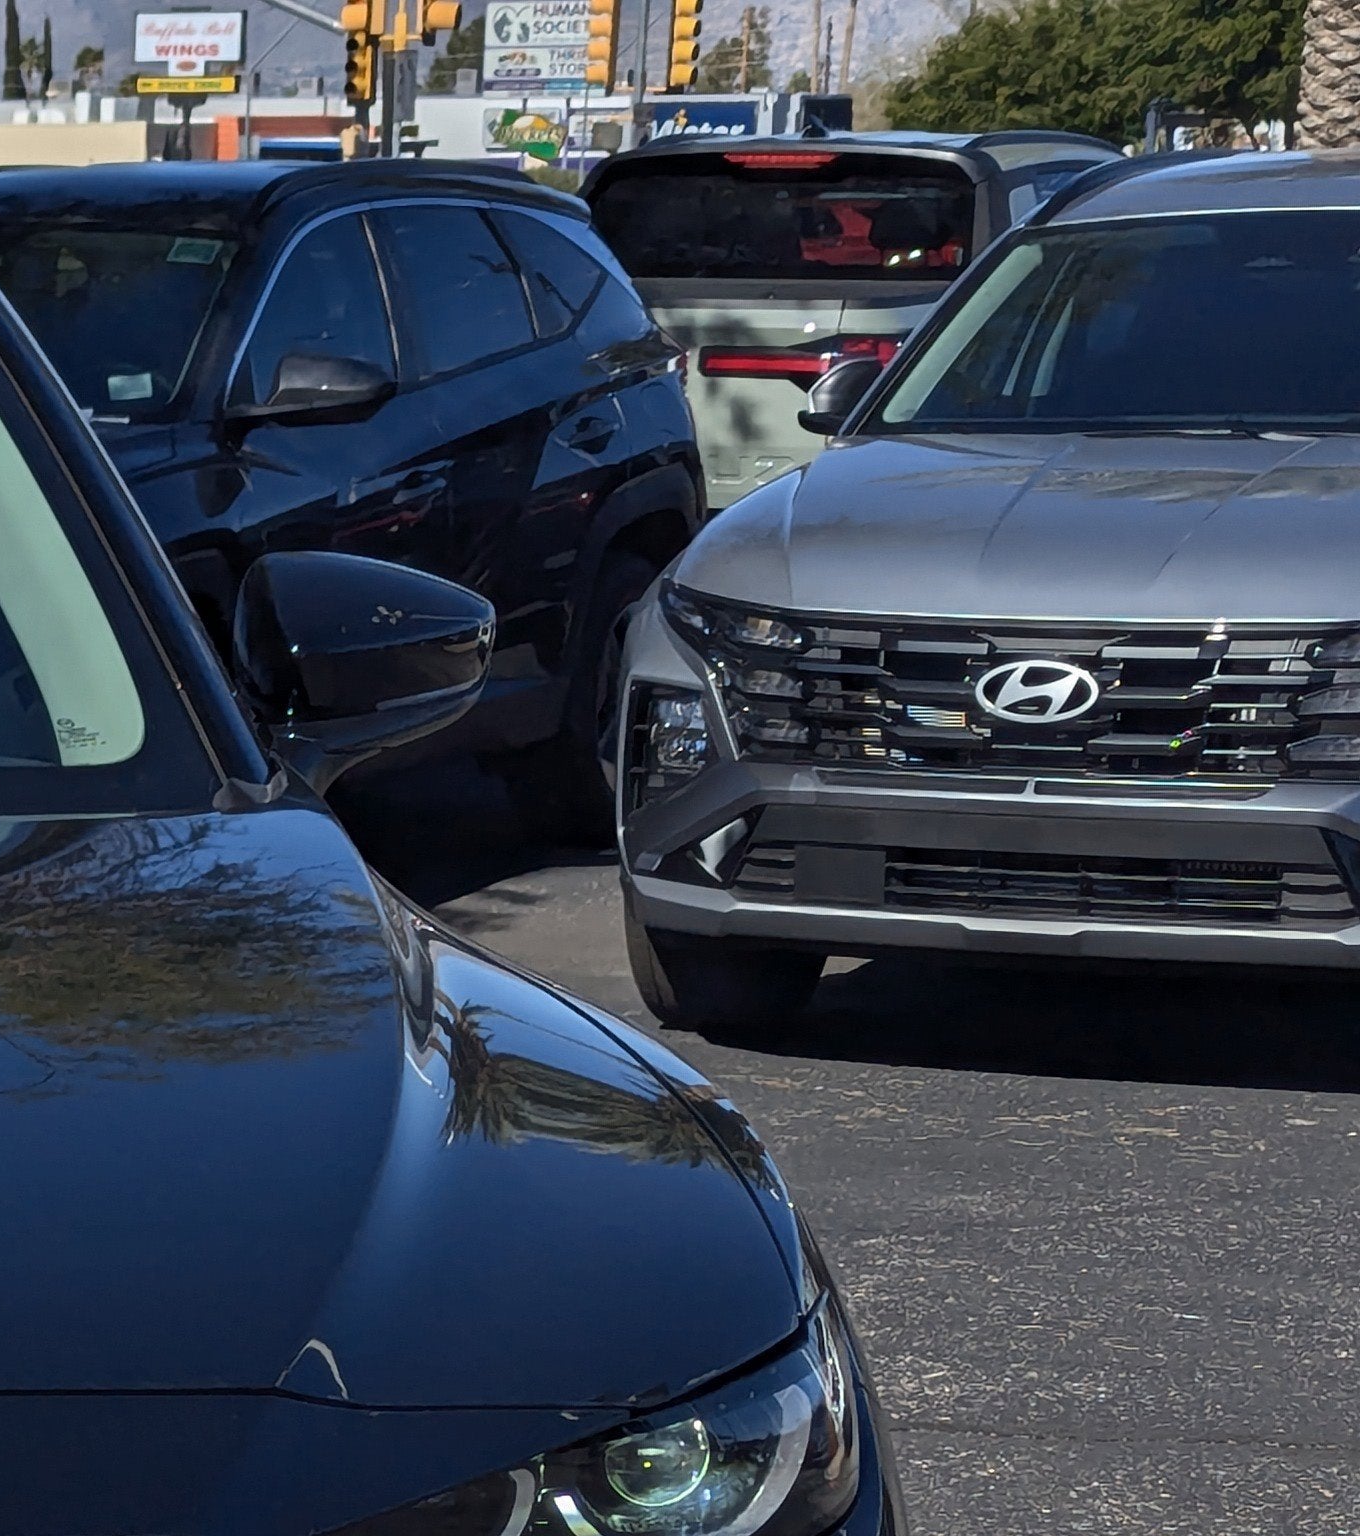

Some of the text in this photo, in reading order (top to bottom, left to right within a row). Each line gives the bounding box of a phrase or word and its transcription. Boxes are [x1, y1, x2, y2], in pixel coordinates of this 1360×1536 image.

[533, 4, 590, 16] HUMAN
[533, 20, 591, 34] SOCIET
[155, 44, 220, 57] WINGS
[549, 63, 587, 76] STOR
